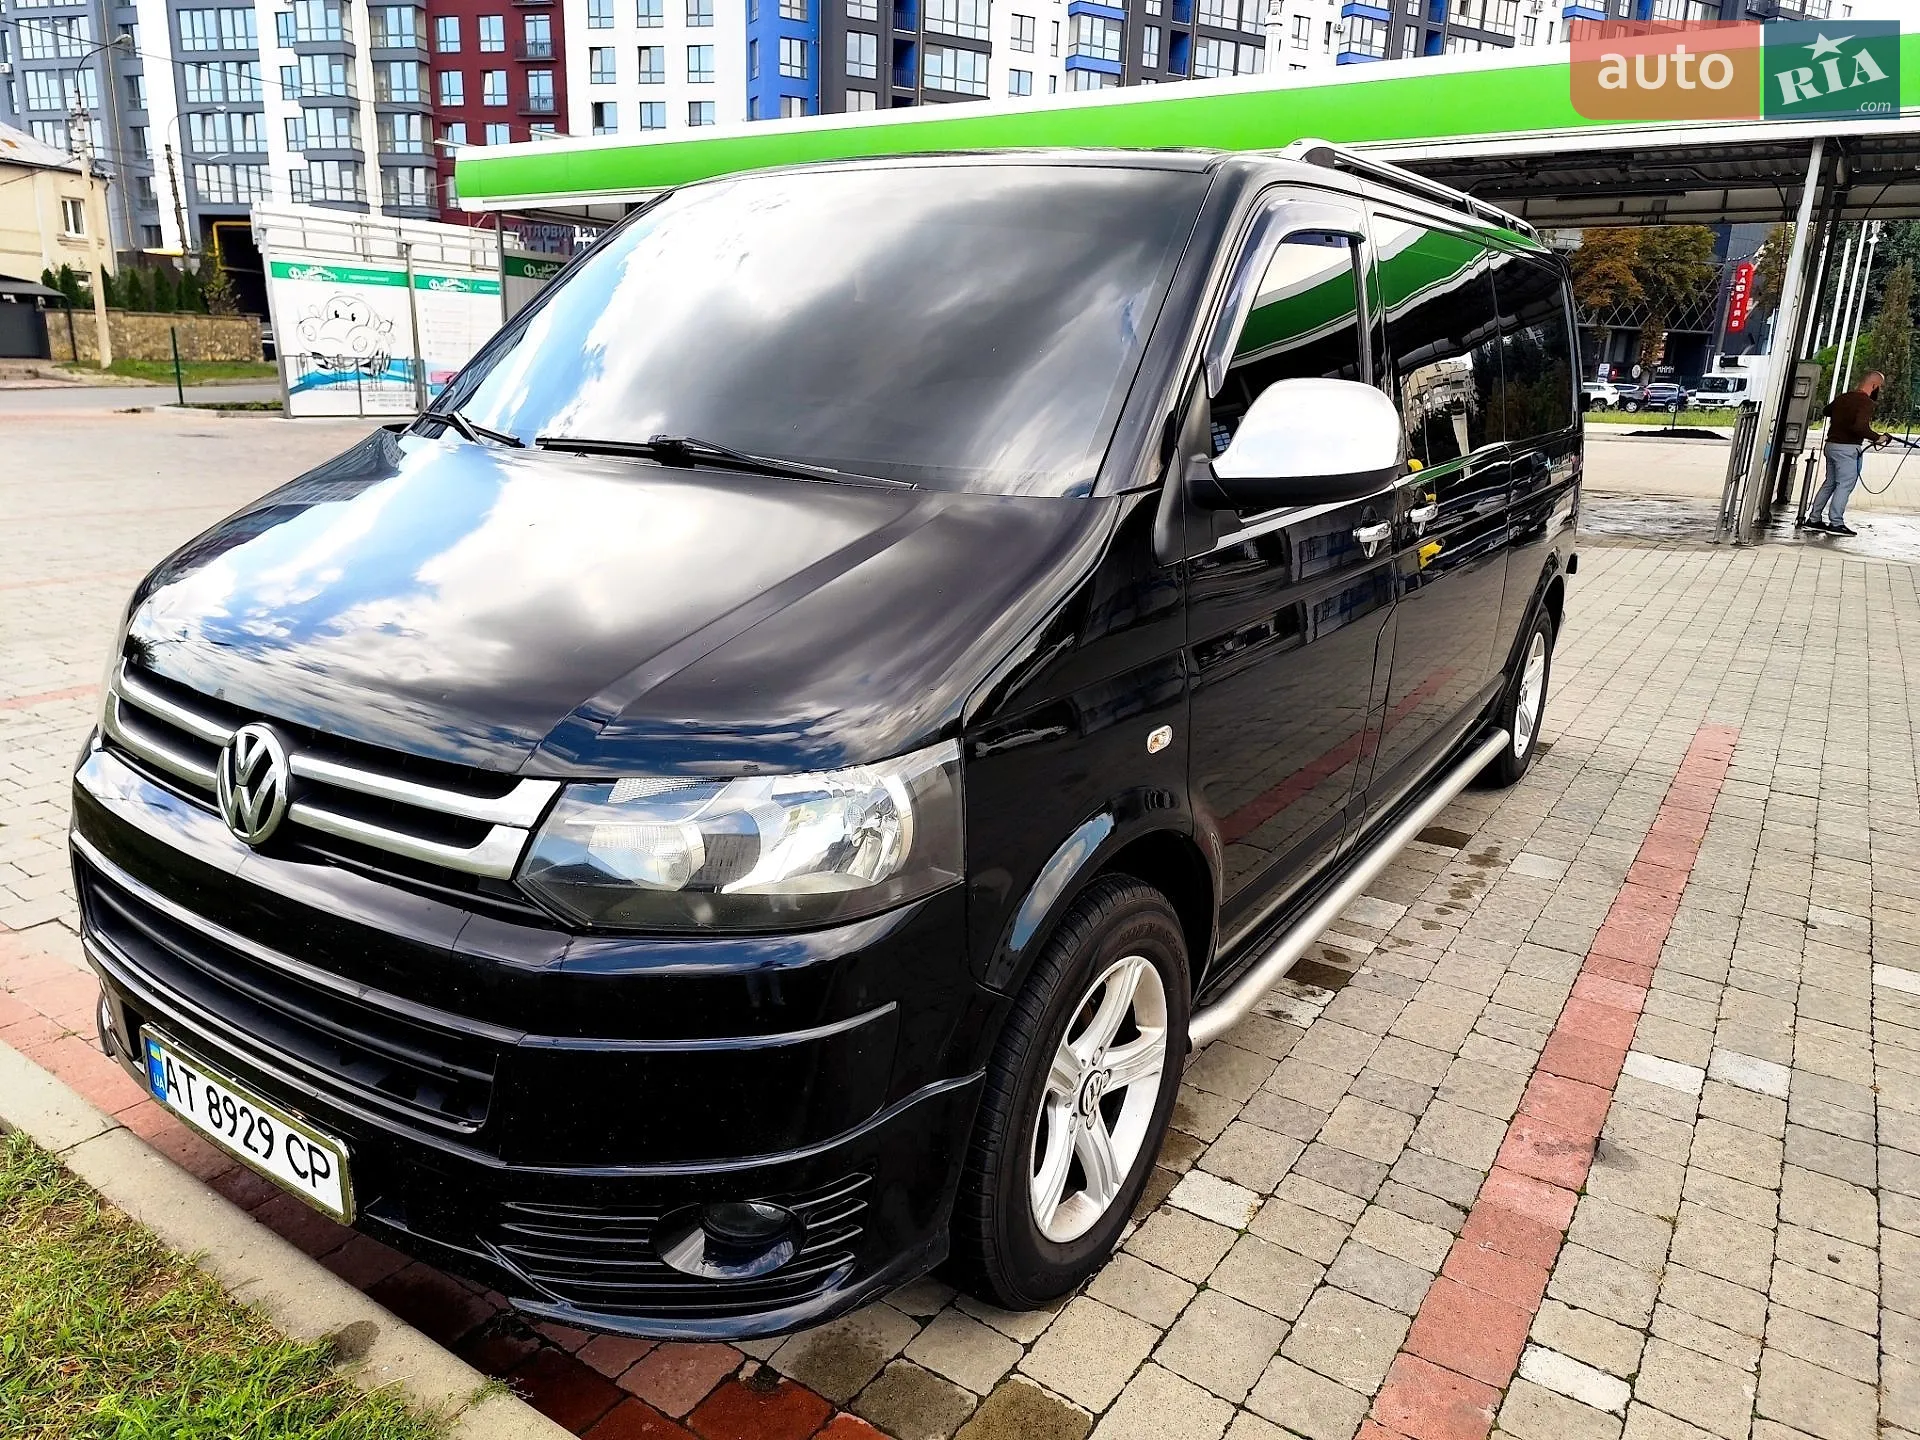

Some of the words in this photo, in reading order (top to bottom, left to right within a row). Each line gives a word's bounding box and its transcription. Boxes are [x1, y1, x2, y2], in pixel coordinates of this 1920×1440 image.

[153, 1073, 165, 1090] UA
[166, 1056, 197, 1112] AT
[205, 1085, 275, 1160] 8929
[285, 1133, 331, 1188] CP
